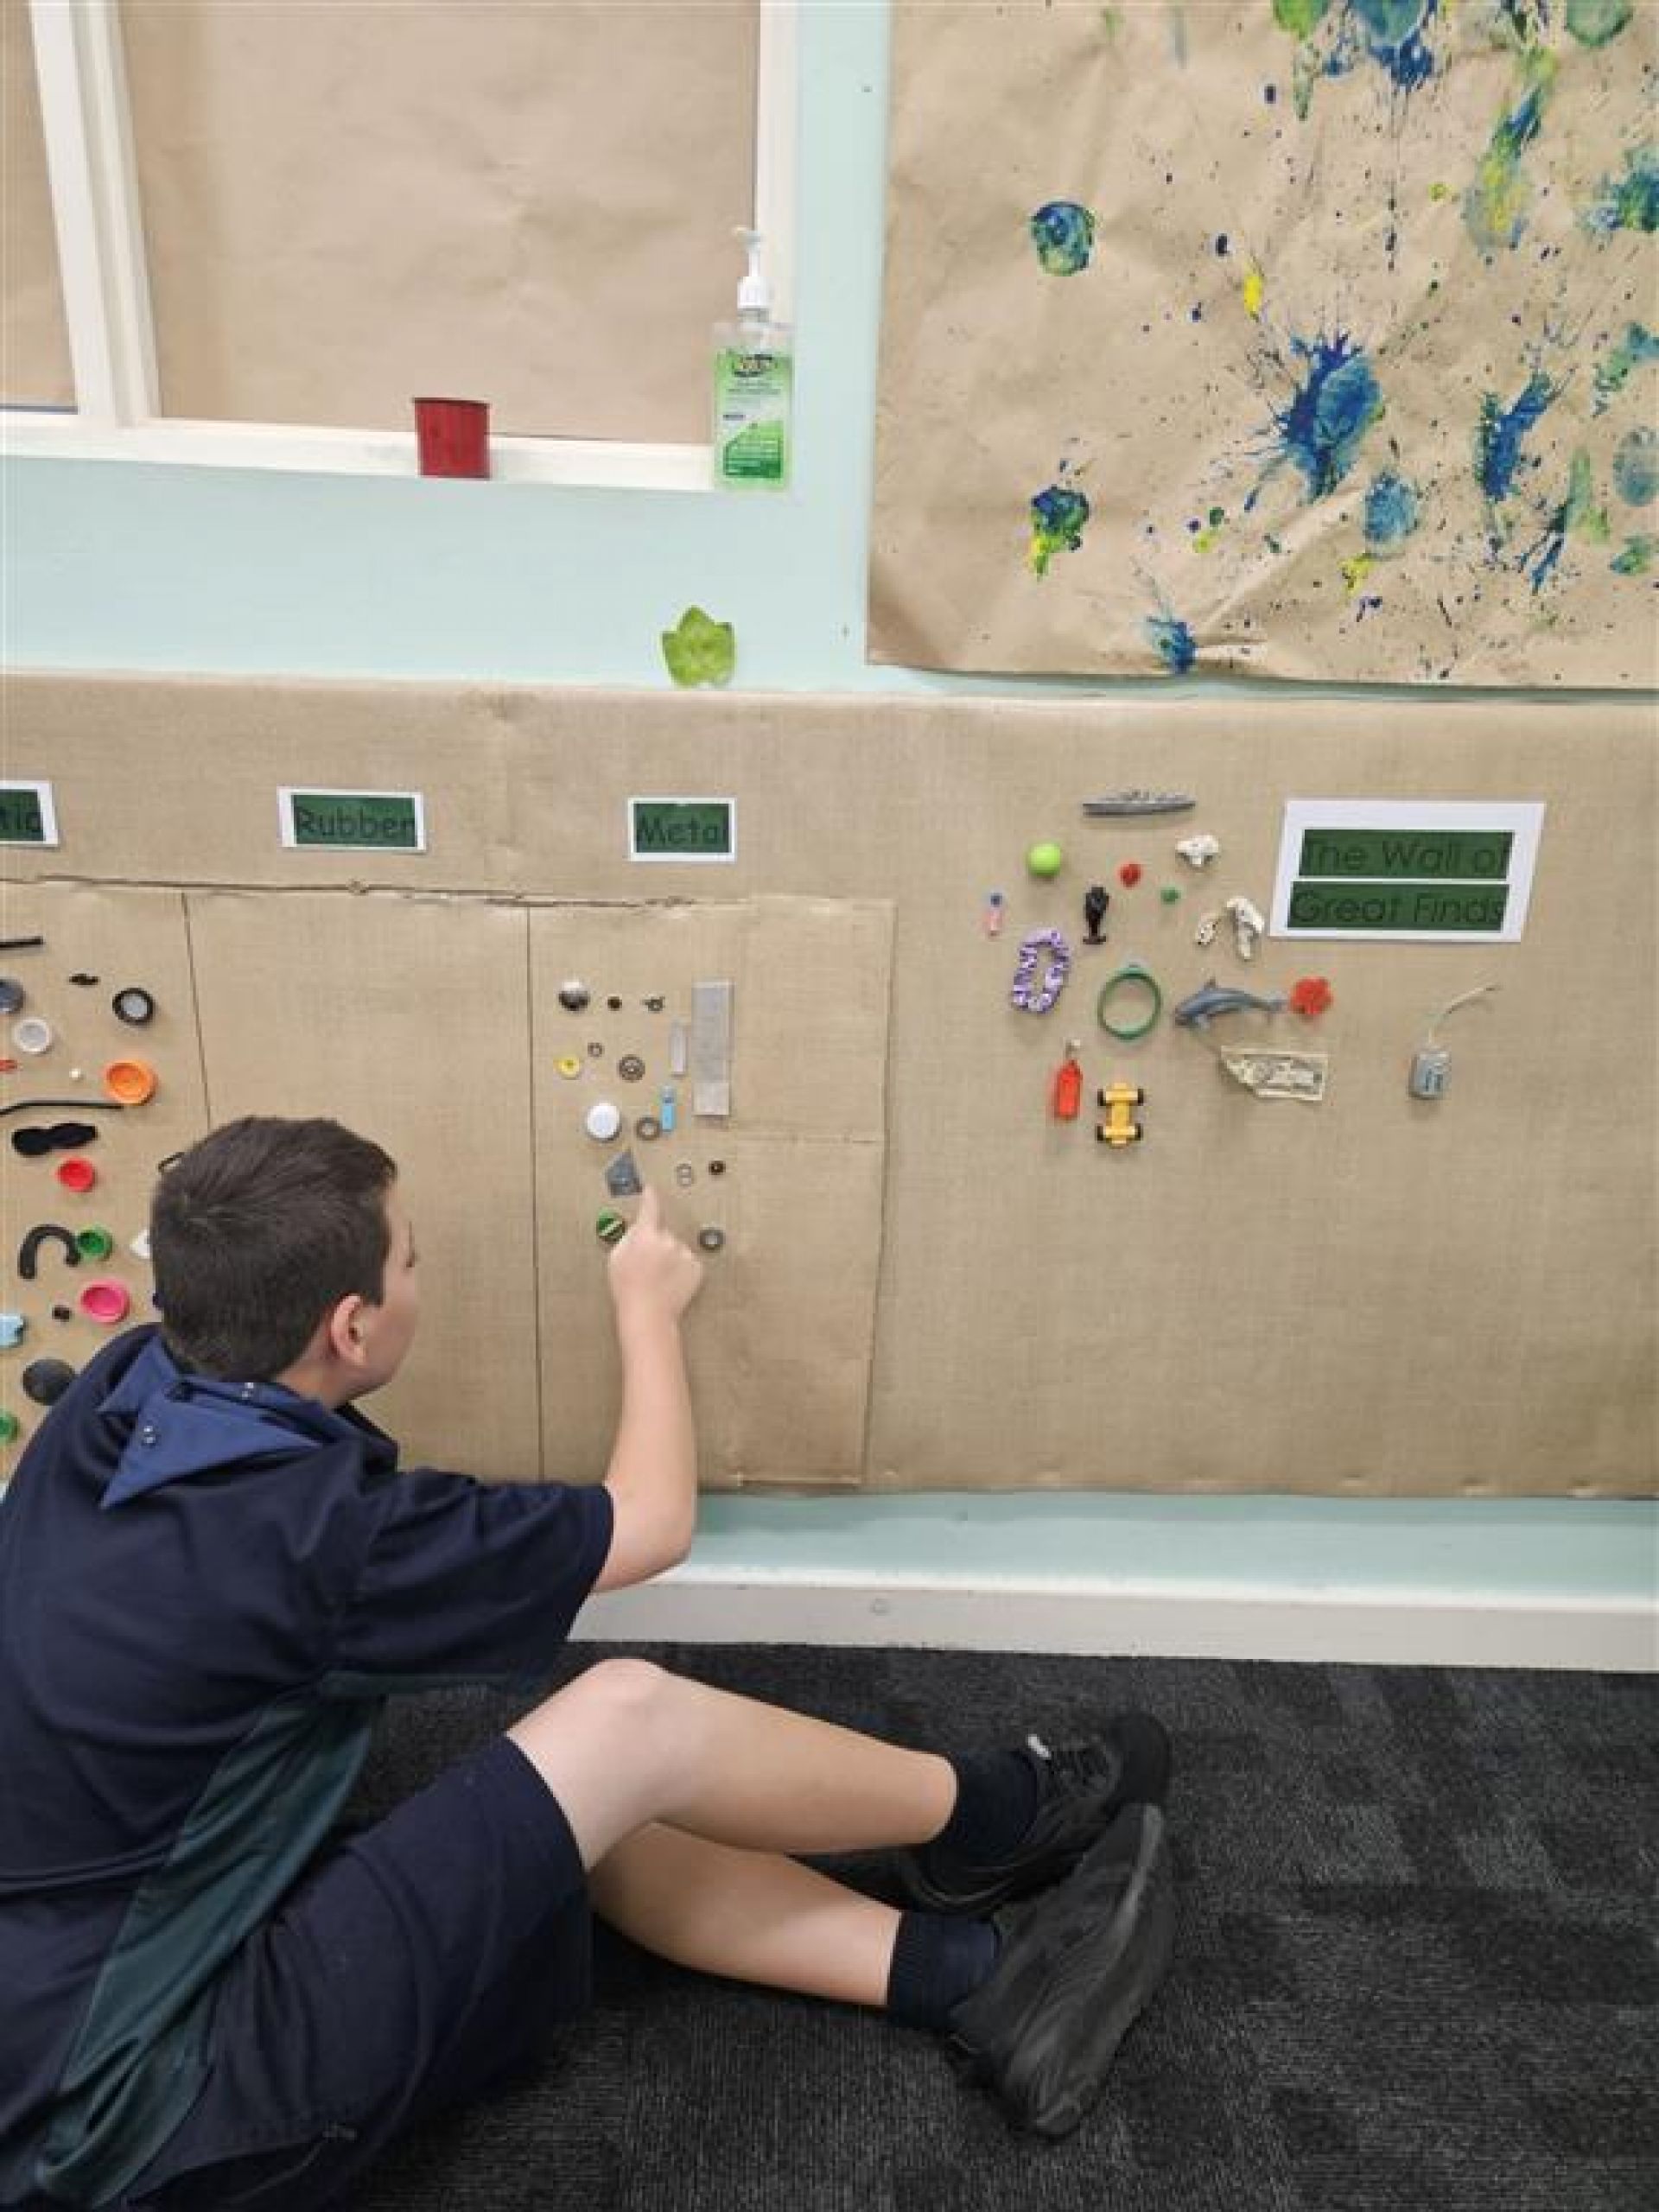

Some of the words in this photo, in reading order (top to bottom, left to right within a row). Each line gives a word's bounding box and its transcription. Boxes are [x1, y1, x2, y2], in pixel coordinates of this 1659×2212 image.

[296, 806, 415, 839] Rubber
[1303, 837, 1367, 870] The
[1382, 839, 1461, 873] Wall
[1474, 839, 1510, 874] of
[1290, 890, 1402, 922] Great
[1414, 891, 1505, 923] Finds
